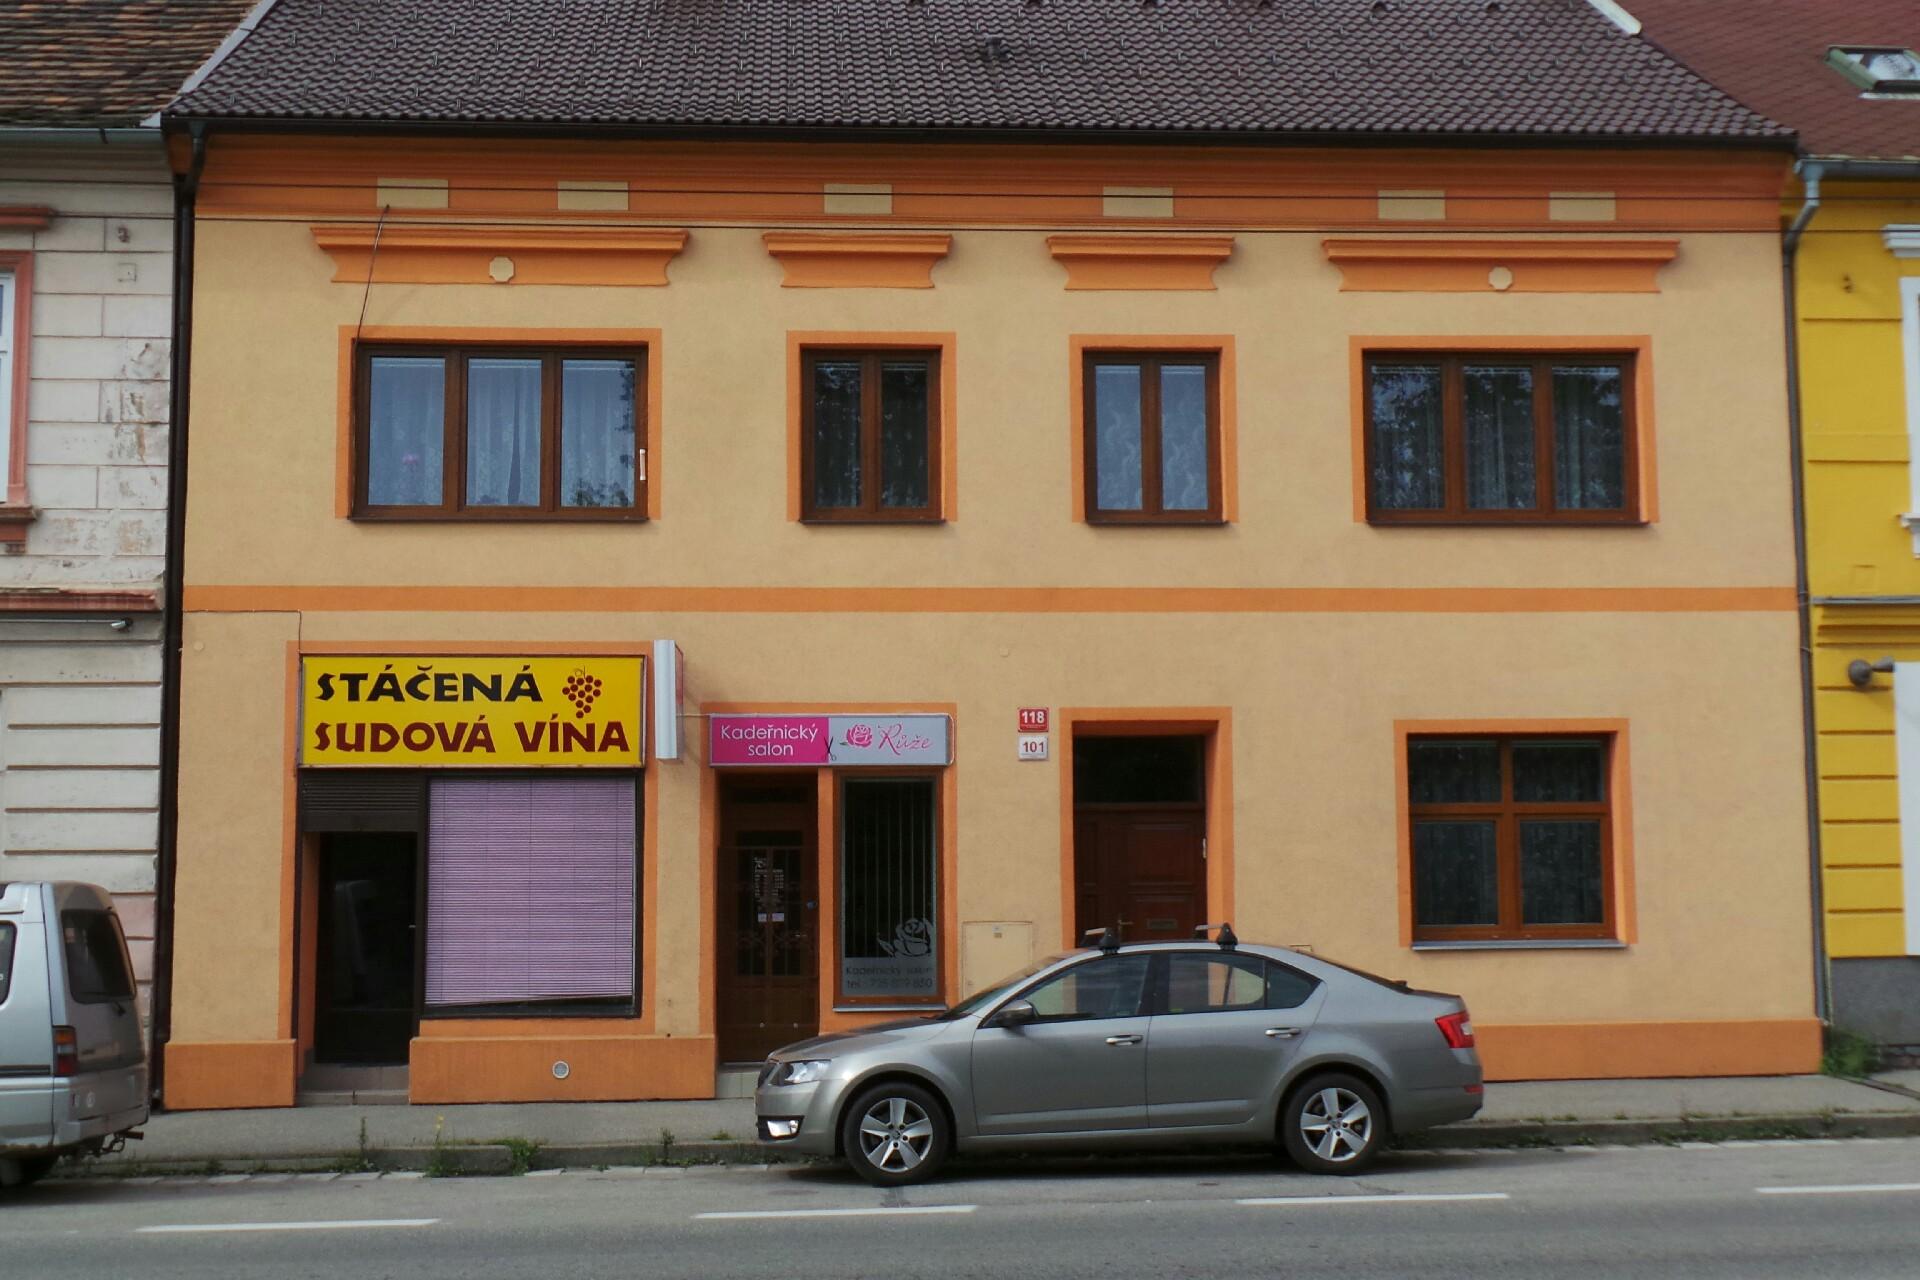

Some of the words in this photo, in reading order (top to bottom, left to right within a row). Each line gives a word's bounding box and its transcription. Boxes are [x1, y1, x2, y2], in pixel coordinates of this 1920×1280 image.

[315, 664, 544, 702] STÁČENÁ
[1021, 711, 1045, 724] 118
[314, 714, 497, 753] SUDOVÁ
[514, 712, 630, 753] VÍNA
[720, 723, 818, 743] Kadeřnický
[878, 723, 933, 756] Růže
[747, 741, 794, 757] salon
[1023, 741, 1044, 753] 101
